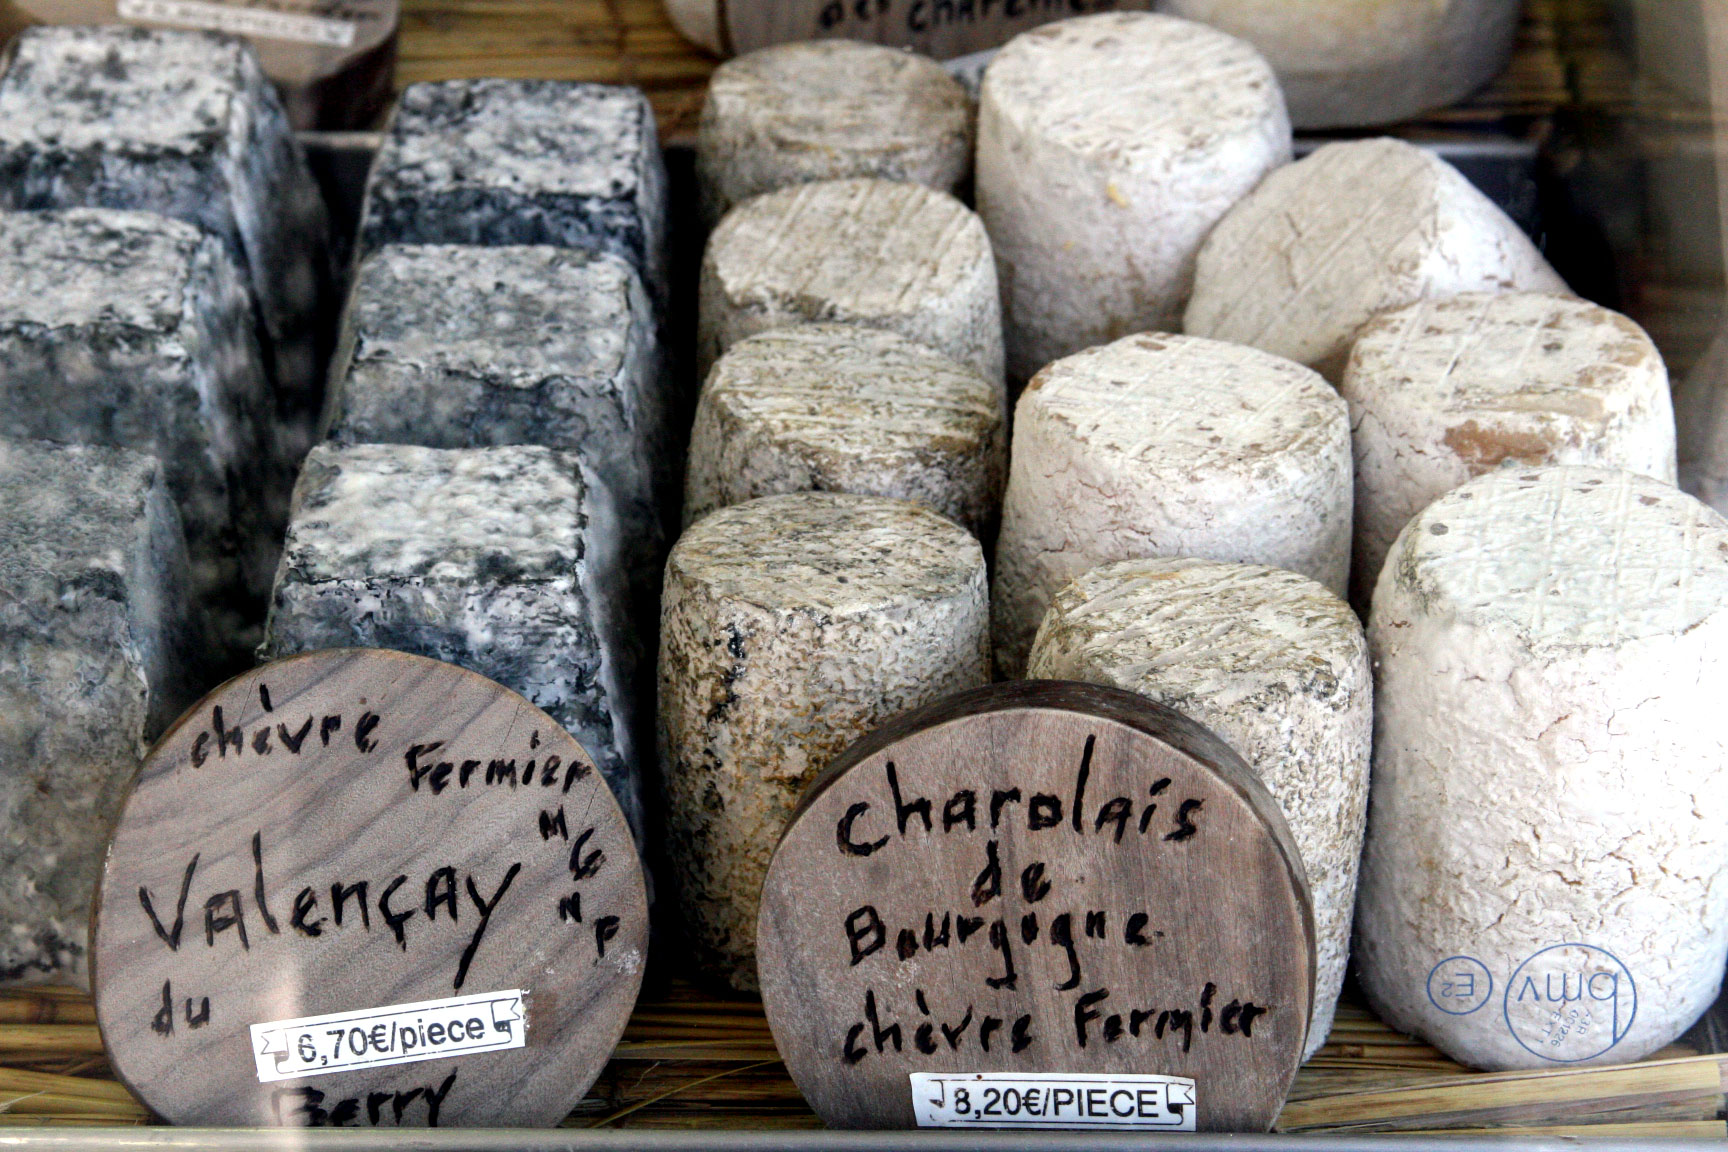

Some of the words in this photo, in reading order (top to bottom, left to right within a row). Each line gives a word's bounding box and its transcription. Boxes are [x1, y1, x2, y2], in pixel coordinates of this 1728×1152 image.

[191, 683, 380, 769] chèvre
[405, 730, 592, 796] Fermier
[970, 839, 1052, 908] de
[150, 978, 211, 1037] du
[842, 988, 1032, 1066] chèvre
[1075, 982, 1268, 1054] Fermier
[1517, 972, 1619, 1046] bmv
[297, 1016, 487, 1066] 6,70€/piece
[273, 1069, 458, 1127] Berry
[953, 1086, 1160, 1120] 8,20€/PIECE
